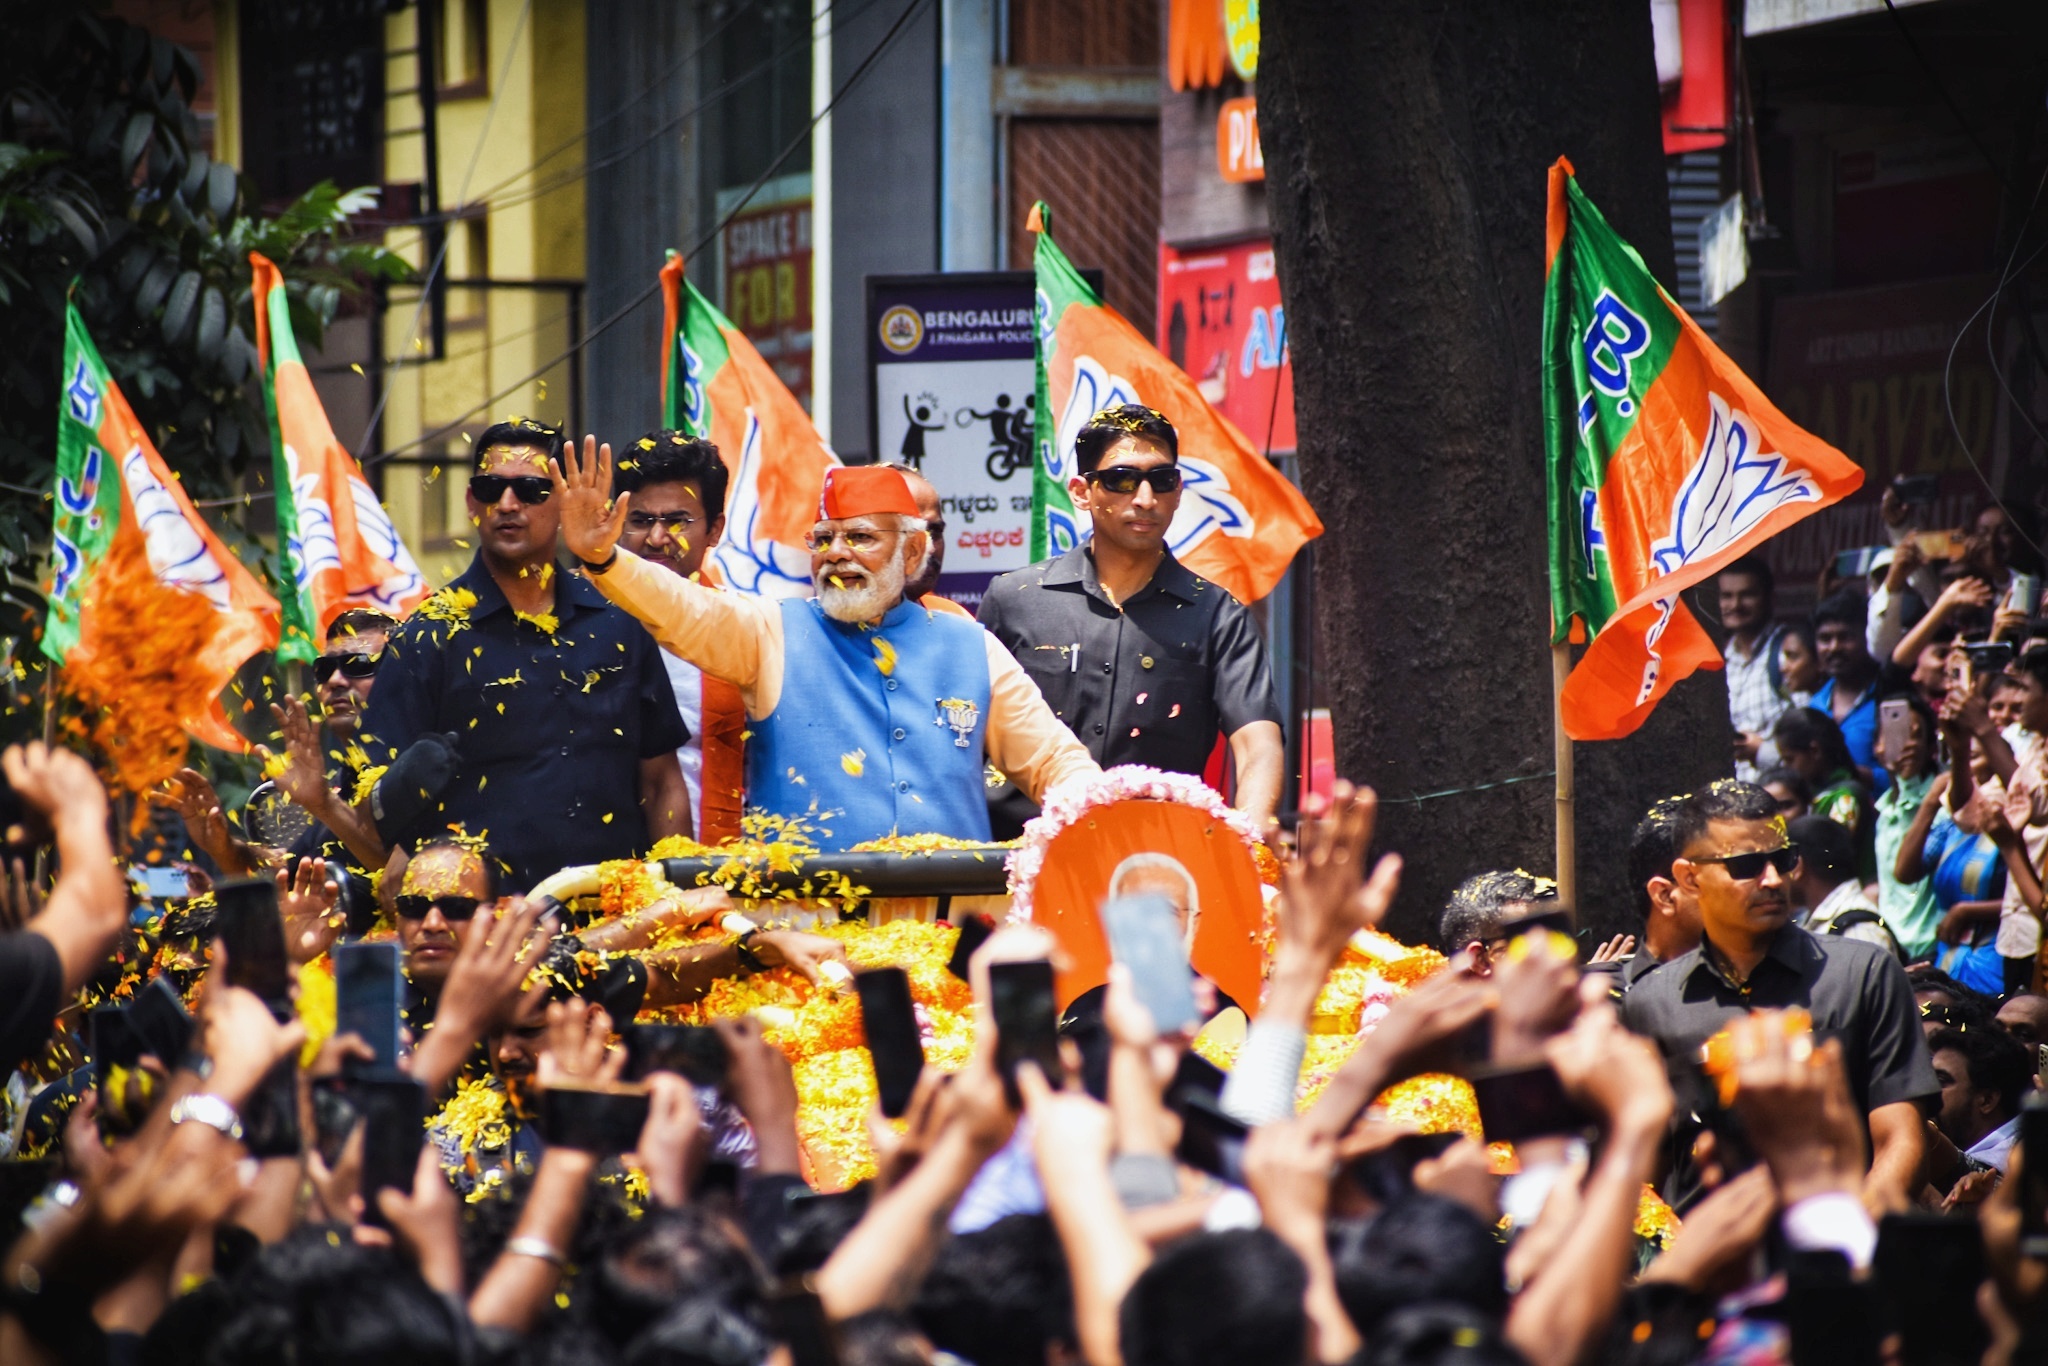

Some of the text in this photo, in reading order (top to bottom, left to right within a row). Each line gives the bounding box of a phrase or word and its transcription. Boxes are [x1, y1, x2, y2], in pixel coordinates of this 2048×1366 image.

[730, 213, 792, 265] SPACE
[731, 260, 796, 330] FOR
[957, 525, 1024, 558] ಎಚ್ಚರಿಕೆ
